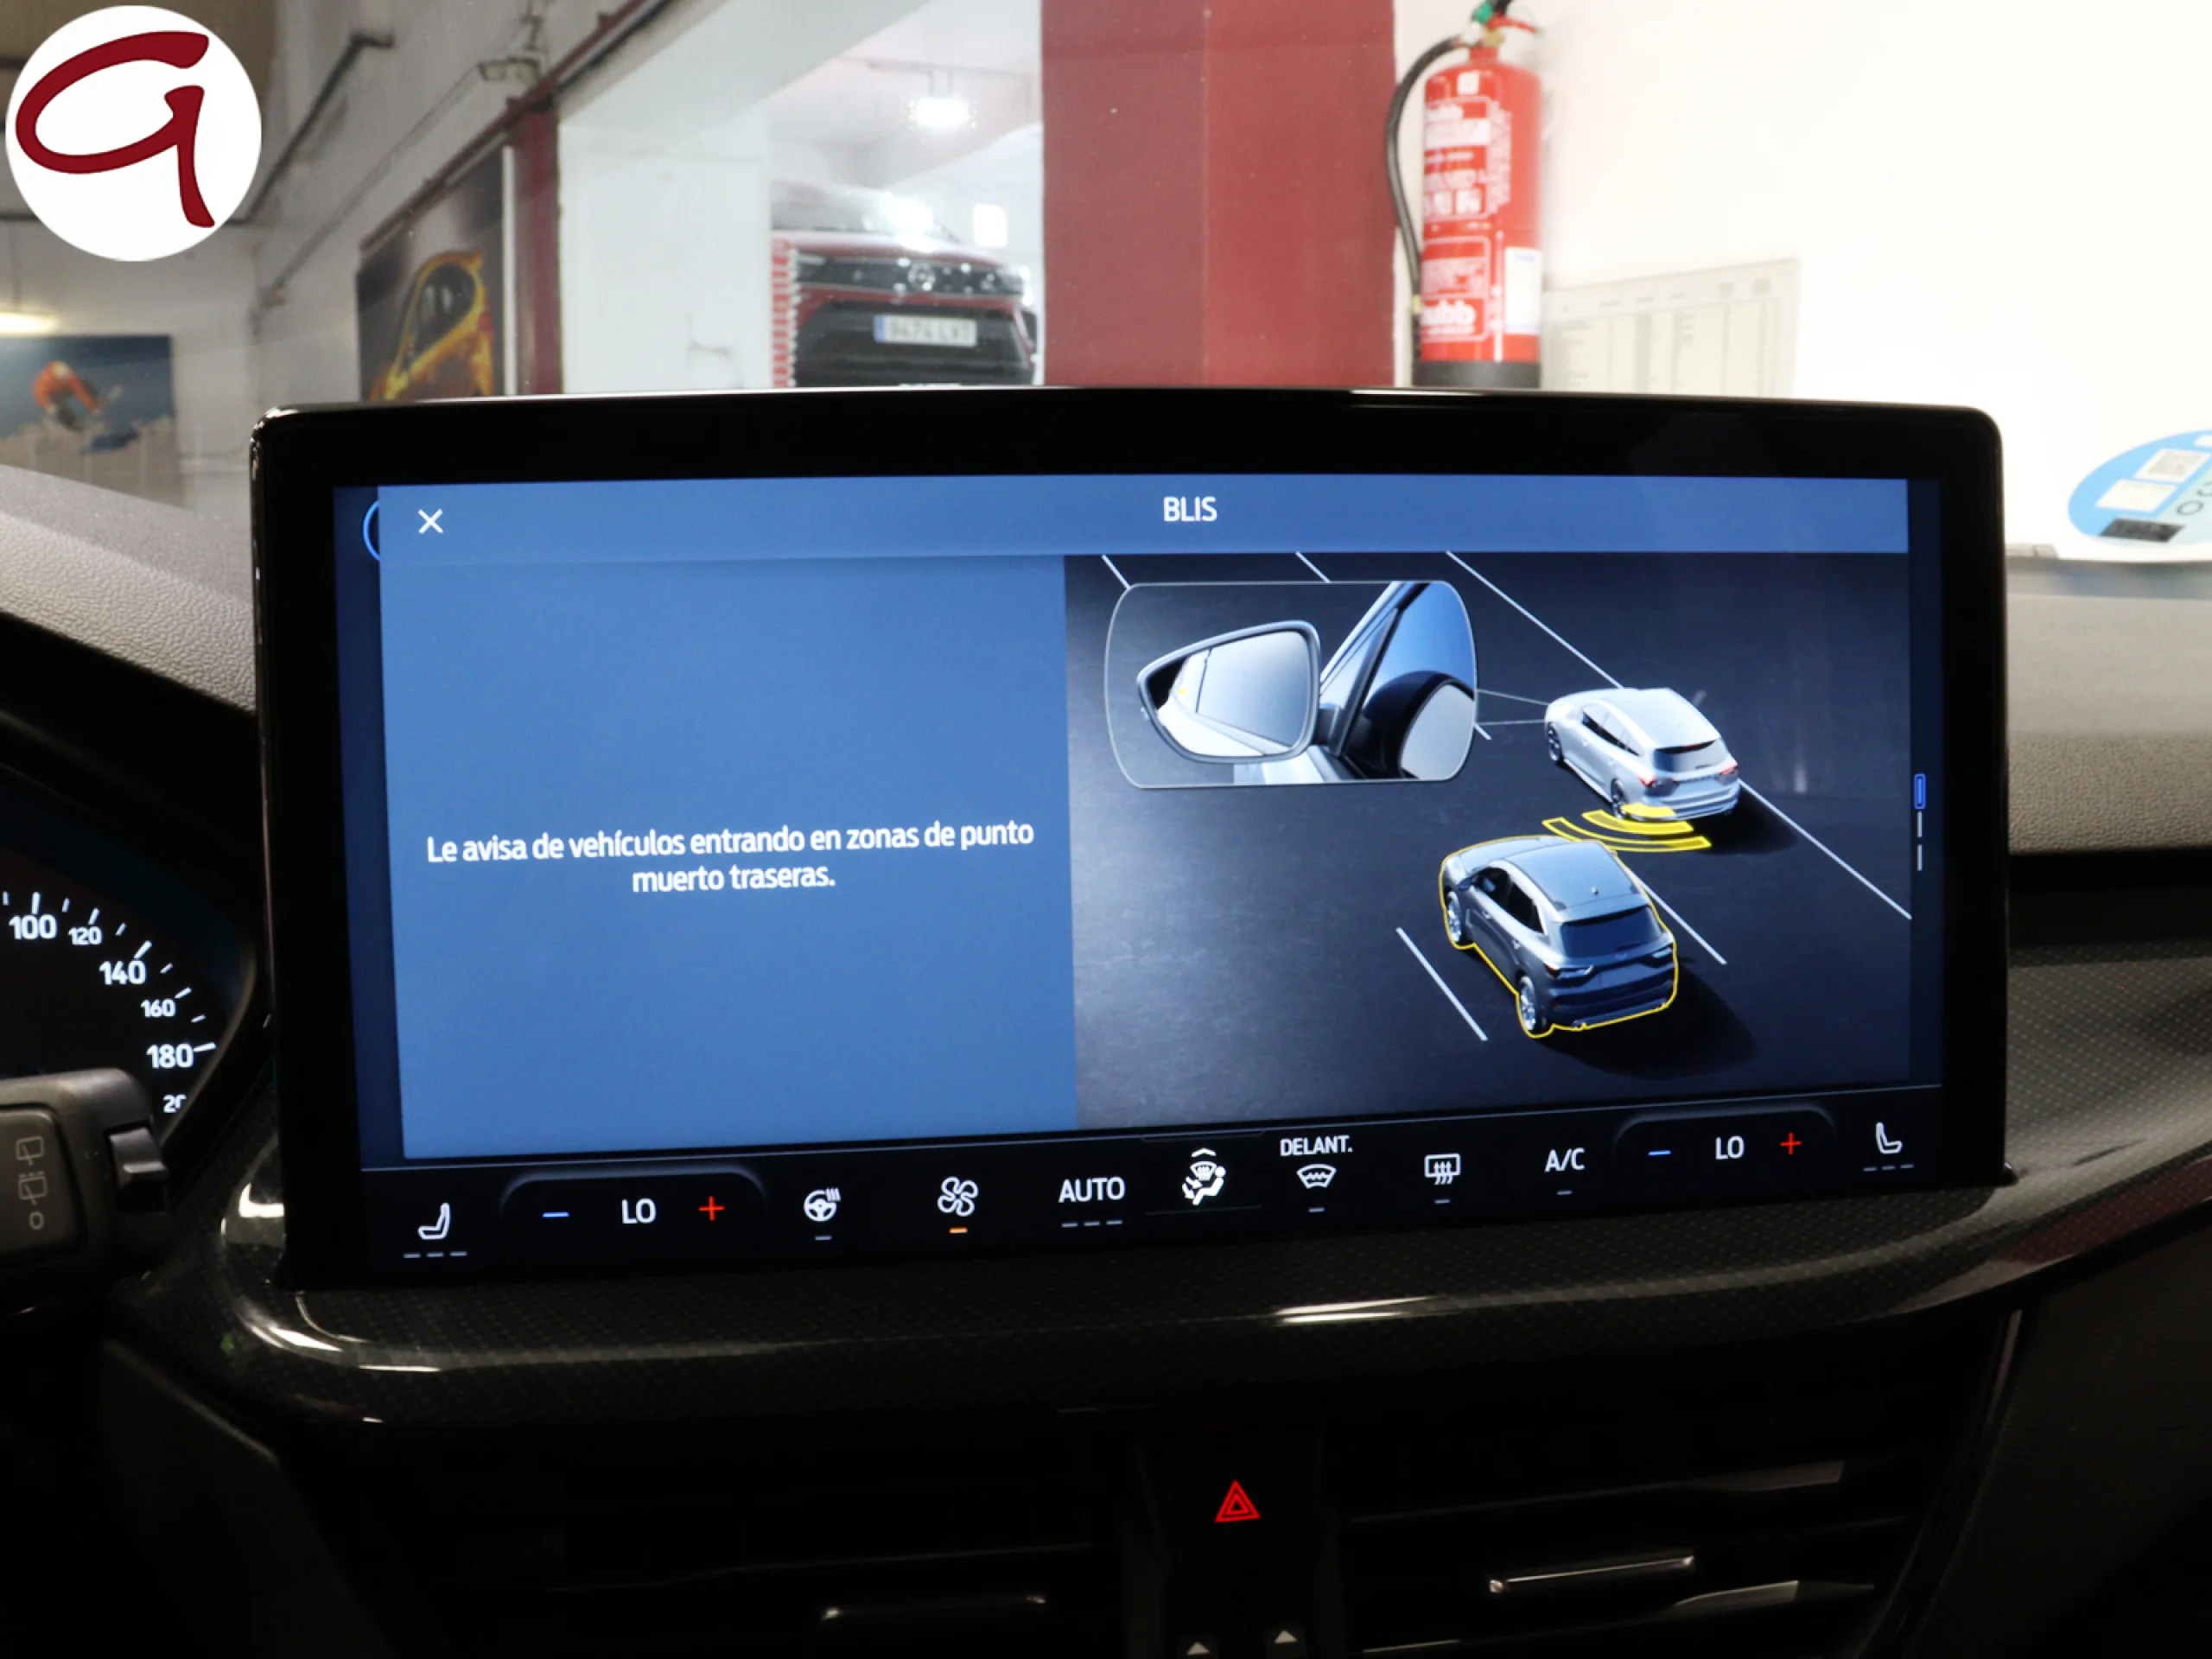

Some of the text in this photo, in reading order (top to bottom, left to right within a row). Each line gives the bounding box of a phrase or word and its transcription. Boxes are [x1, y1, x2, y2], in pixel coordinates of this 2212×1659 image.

[1163, 496, 1217, 522] BLIS
[427, 819, 1034, 863] Le avisa de vehículos entrando en zonas de punto
[632, 864, 836, 893] muerto traseras.
[9, 914, 57, 940] 100
[68, 926, 103, 946] 120
[99, 959, 147, 986] 140
[140, 998, 176, 1018] 160
[146, 1043, 194, 1069] 180
[1279, 1135, 1354, 1158] DELANT.
[1715, 1135, 1745, 1160] LO
[1545, 1147, 1586, 1173] A/C
[1058, 1176, 1126, 1205] AUTO
[620, 1198, 657, 1224] LO
